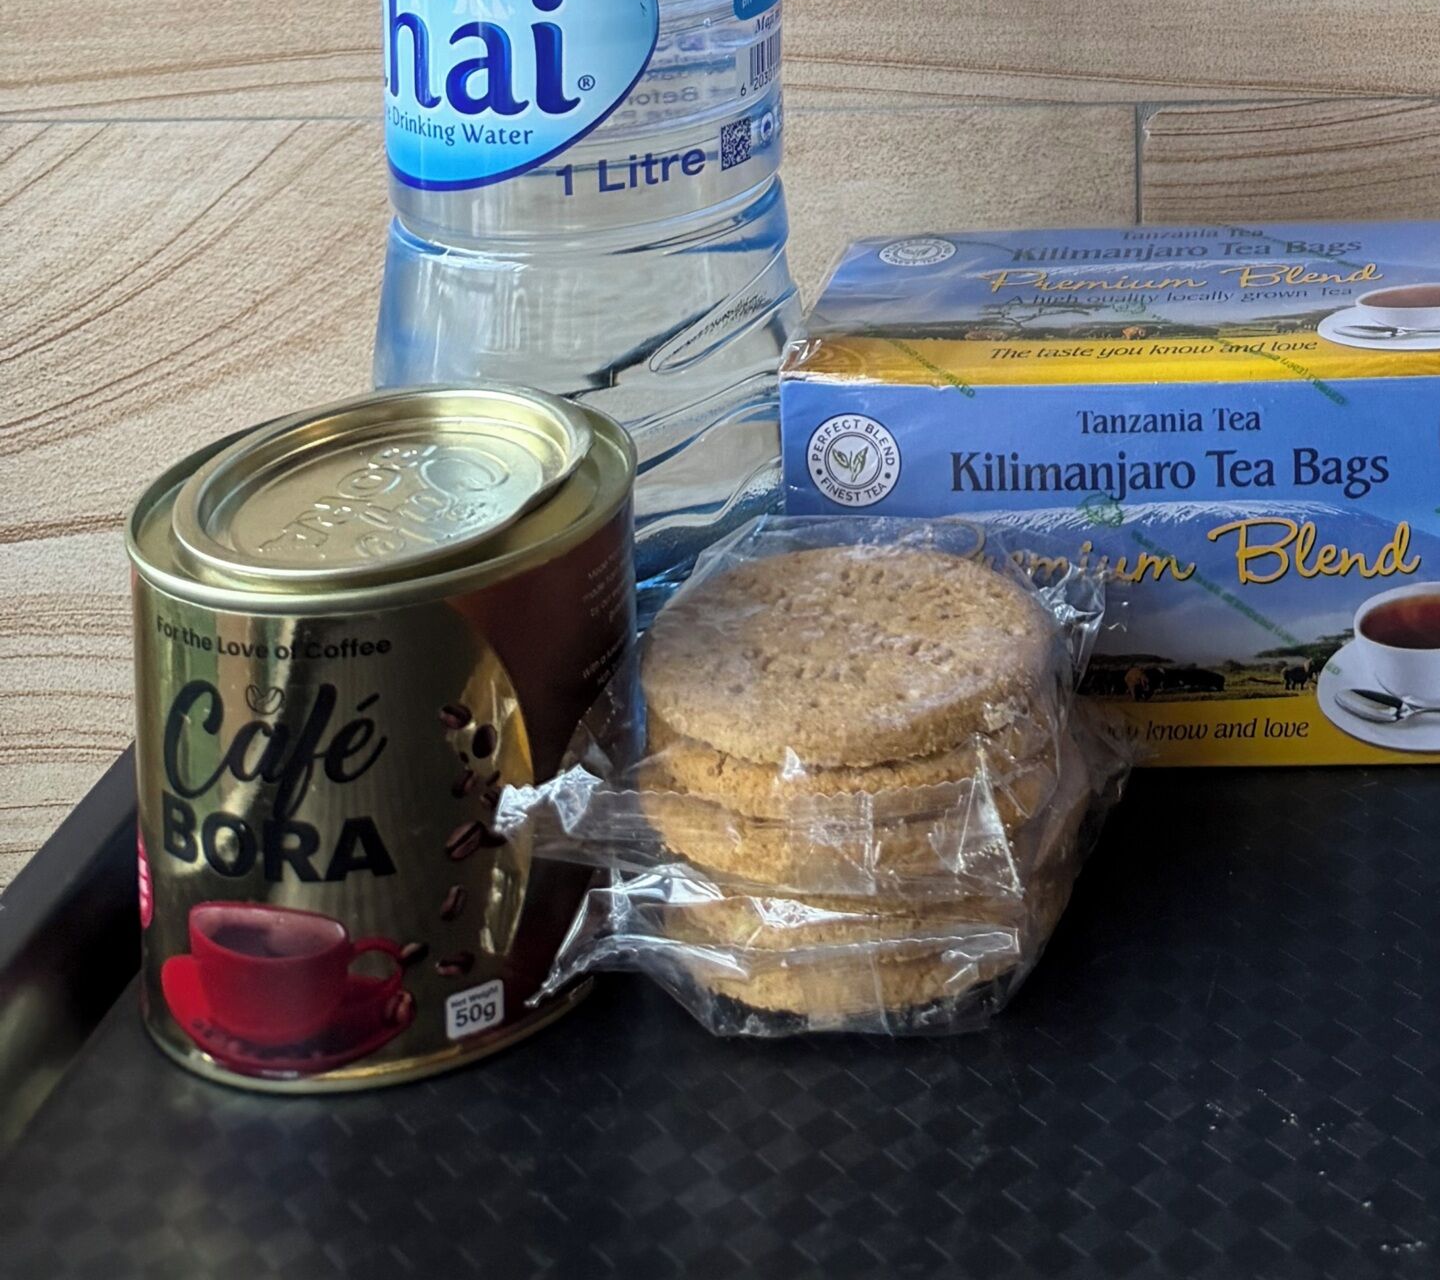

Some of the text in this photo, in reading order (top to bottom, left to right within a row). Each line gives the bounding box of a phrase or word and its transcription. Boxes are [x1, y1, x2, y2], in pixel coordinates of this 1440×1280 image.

[393, 112, 533, 147] Drinking Water
[556, 148, 706, 196] 1 Litre
[1121, 227, 1263, 241] Tanzania Tea
[1011, 239, 1362, 263] Kilimanjaro Tea Bags
[977, 263, 1384, 293] Premium Blend
[1003, 295, 1024, 306] A
[1167, 291, 1233, 303] locally
[1240, 289, 1308, 302] grown
[1321, 287, 1352, 297] Tea
[990, 340, 1318, 360] The taste you know and love
[1076, 407, 1262, 434] Tanzania Tea
[811, 418, 896, 466] PERFECT BLEND
[820, 476, 887, 502] FINEST TEA
[950, 447, 1390, 502] Kilimanjaro Tea Bags
[1207, 517, 1422, 585] Blend
[156, 615, 392, 660] For the Love of Coffee
[1146, 721, 1208, 741] know
[1214, 718, 1259, 738] and
[1265, 718, 1309, 737] love
[163, 679, 388, 826] Café
[161, 790, 396, 884] BORA
[455, 1001, 496, 1028] 50g
